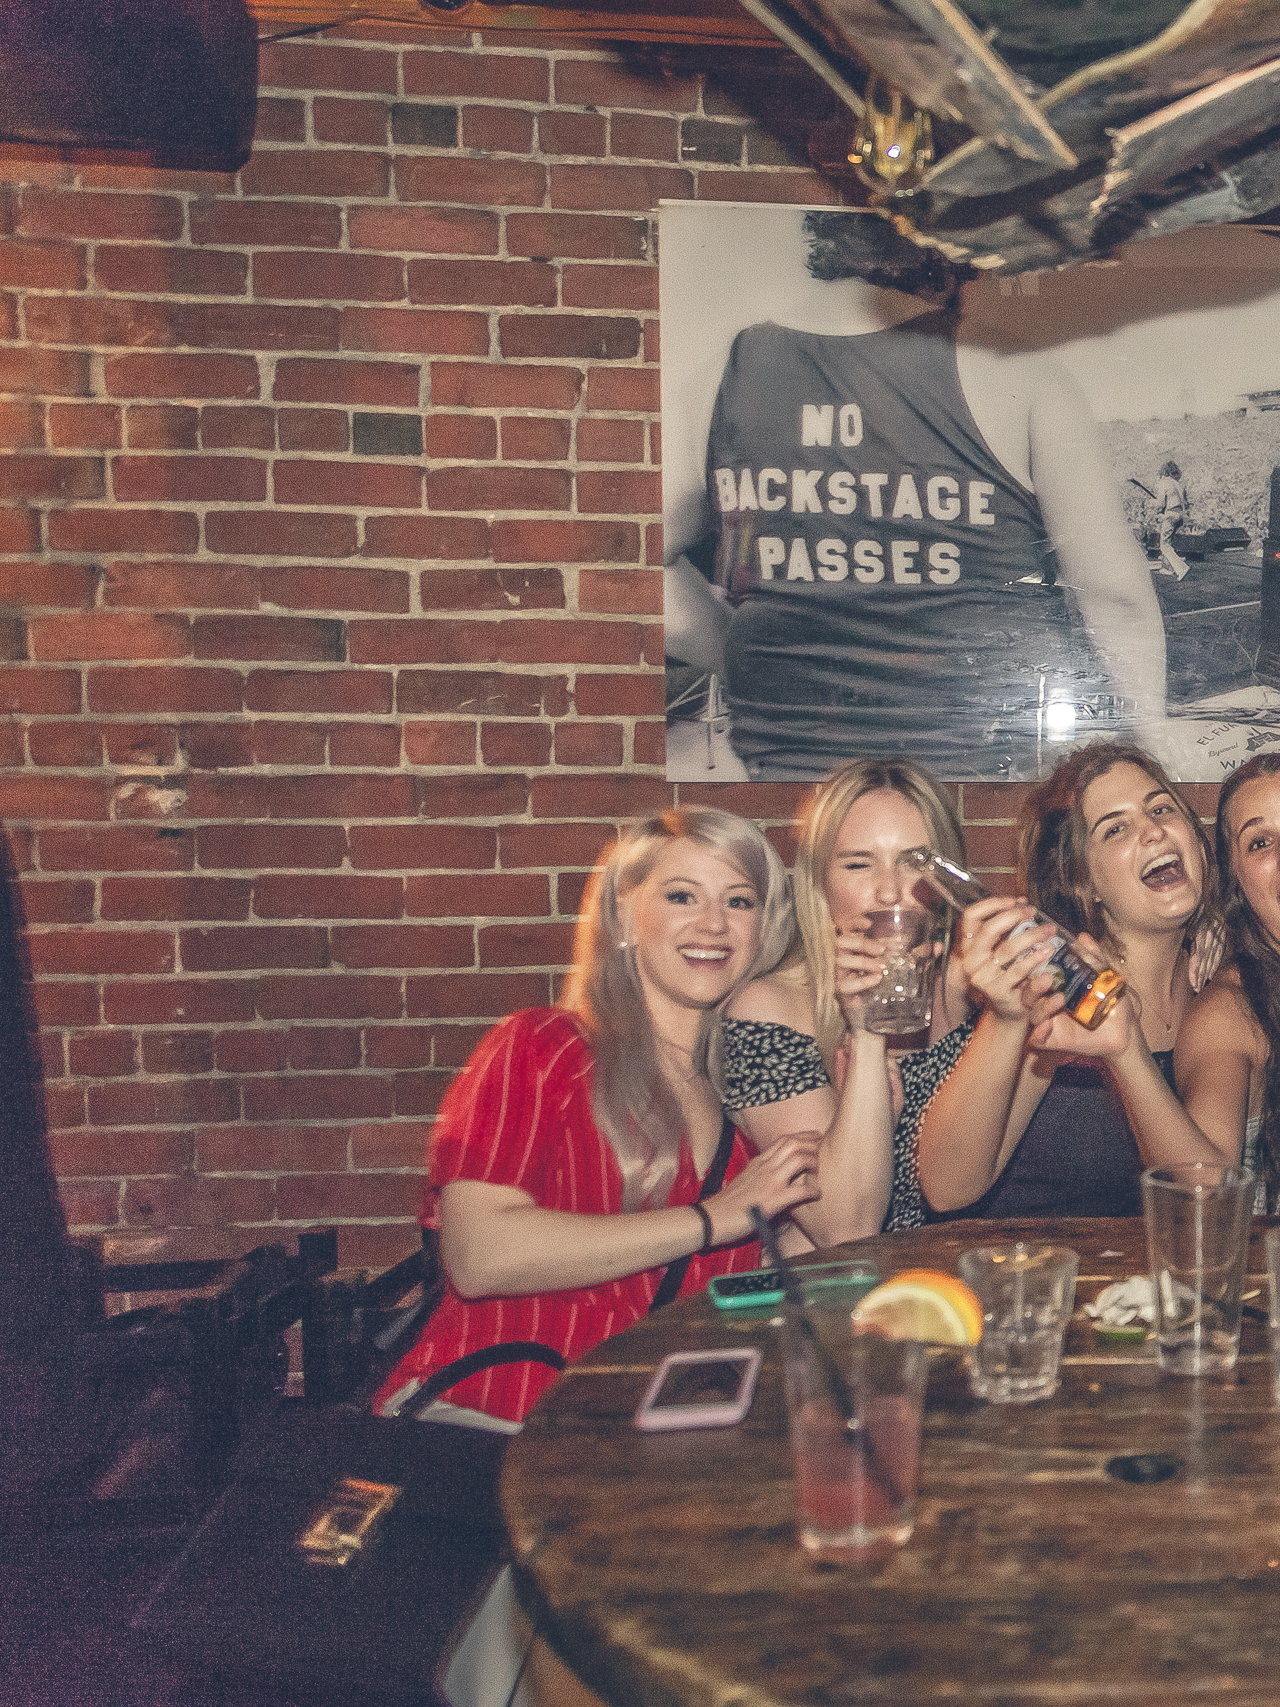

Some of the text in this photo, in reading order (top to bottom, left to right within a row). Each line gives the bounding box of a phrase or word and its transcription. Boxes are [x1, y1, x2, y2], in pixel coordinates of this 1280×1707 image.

[801, 402, 863, 447] NO
[714, 467, 995, 525] BACKSTAGE
[758, 536, 960, 584] PASSES
[1196, 735, 1215, 746] EL
